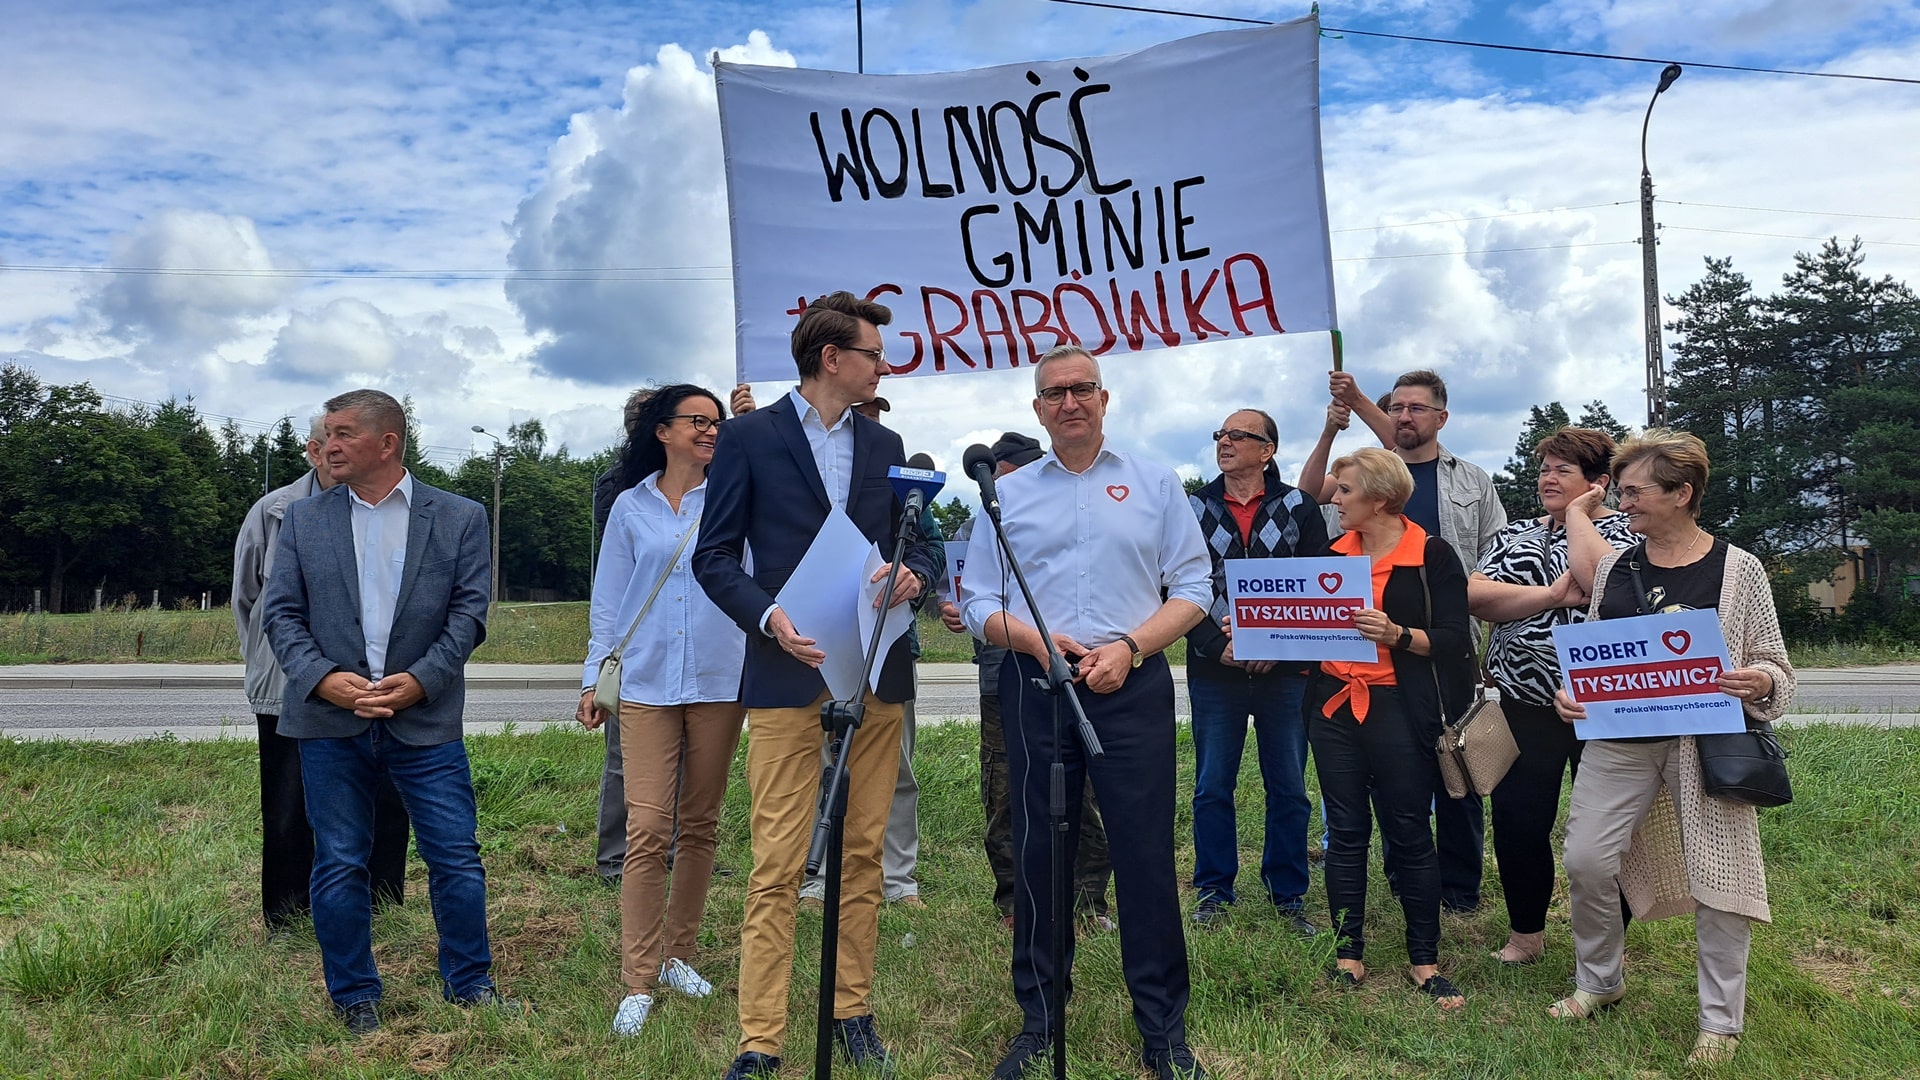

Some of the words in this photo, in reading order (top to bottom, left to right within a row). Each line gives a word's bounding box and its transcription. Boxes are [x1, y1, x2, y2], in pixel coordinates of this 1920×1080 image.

[960, 176, 1211, 289] GMINIE
[1237, 578, 1307, 593] ROBERT
[1568, 640, 1649, 663] ROBERT
[1573, 666, 1719, 694] TYSZKIEWICZ
[1614, 699, 1731, 715] #PolskaWNaszychSercach
